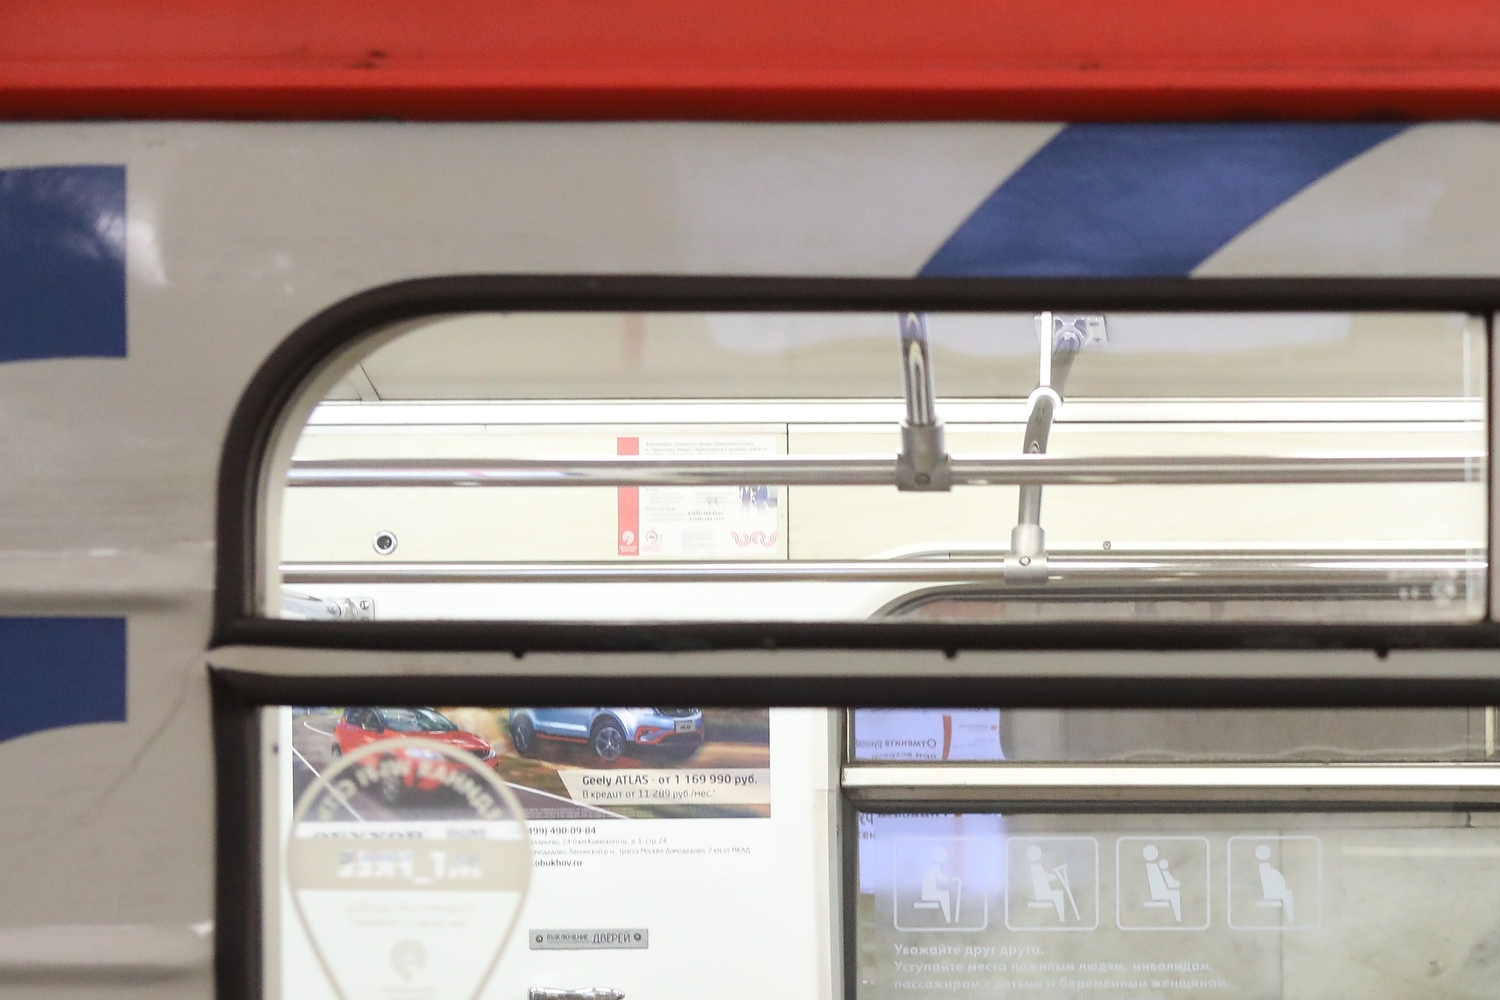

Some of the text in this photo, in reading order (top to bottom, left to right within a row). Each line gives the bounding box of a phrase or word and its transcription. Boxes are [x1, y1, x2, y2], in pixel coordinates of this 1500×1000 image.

[582, 774, 612, 787] Geely
[615, 774, 649, 785] ATLAS
[658, 777, 672, 785] от
[675, 774, 680, 784] 1
[685, 774, 706, 784] 169
[709, 774, 731, 784] 990
[734, 773, 757, 786] руб.
[582, 789, 589, 799] В
[591, 790, 622, 800] кредит
[625, 790, 635, 799] от
[652, 789, 671, 798] 289
[592, 931, 631, 944] ДВЕРЕЙ
[894, 943, 1044, 957] Уважайте друг друга.
[894, 961, 1213, 975] Уступайте места пожилым людям, инвалидам,
[894, 981, 980, 992] пассажирам
[995, 981, 1042, 990] детьми
[1059, 976, 1148, 992] беременным
[1151, 980, 1229, 990] женщинам.
